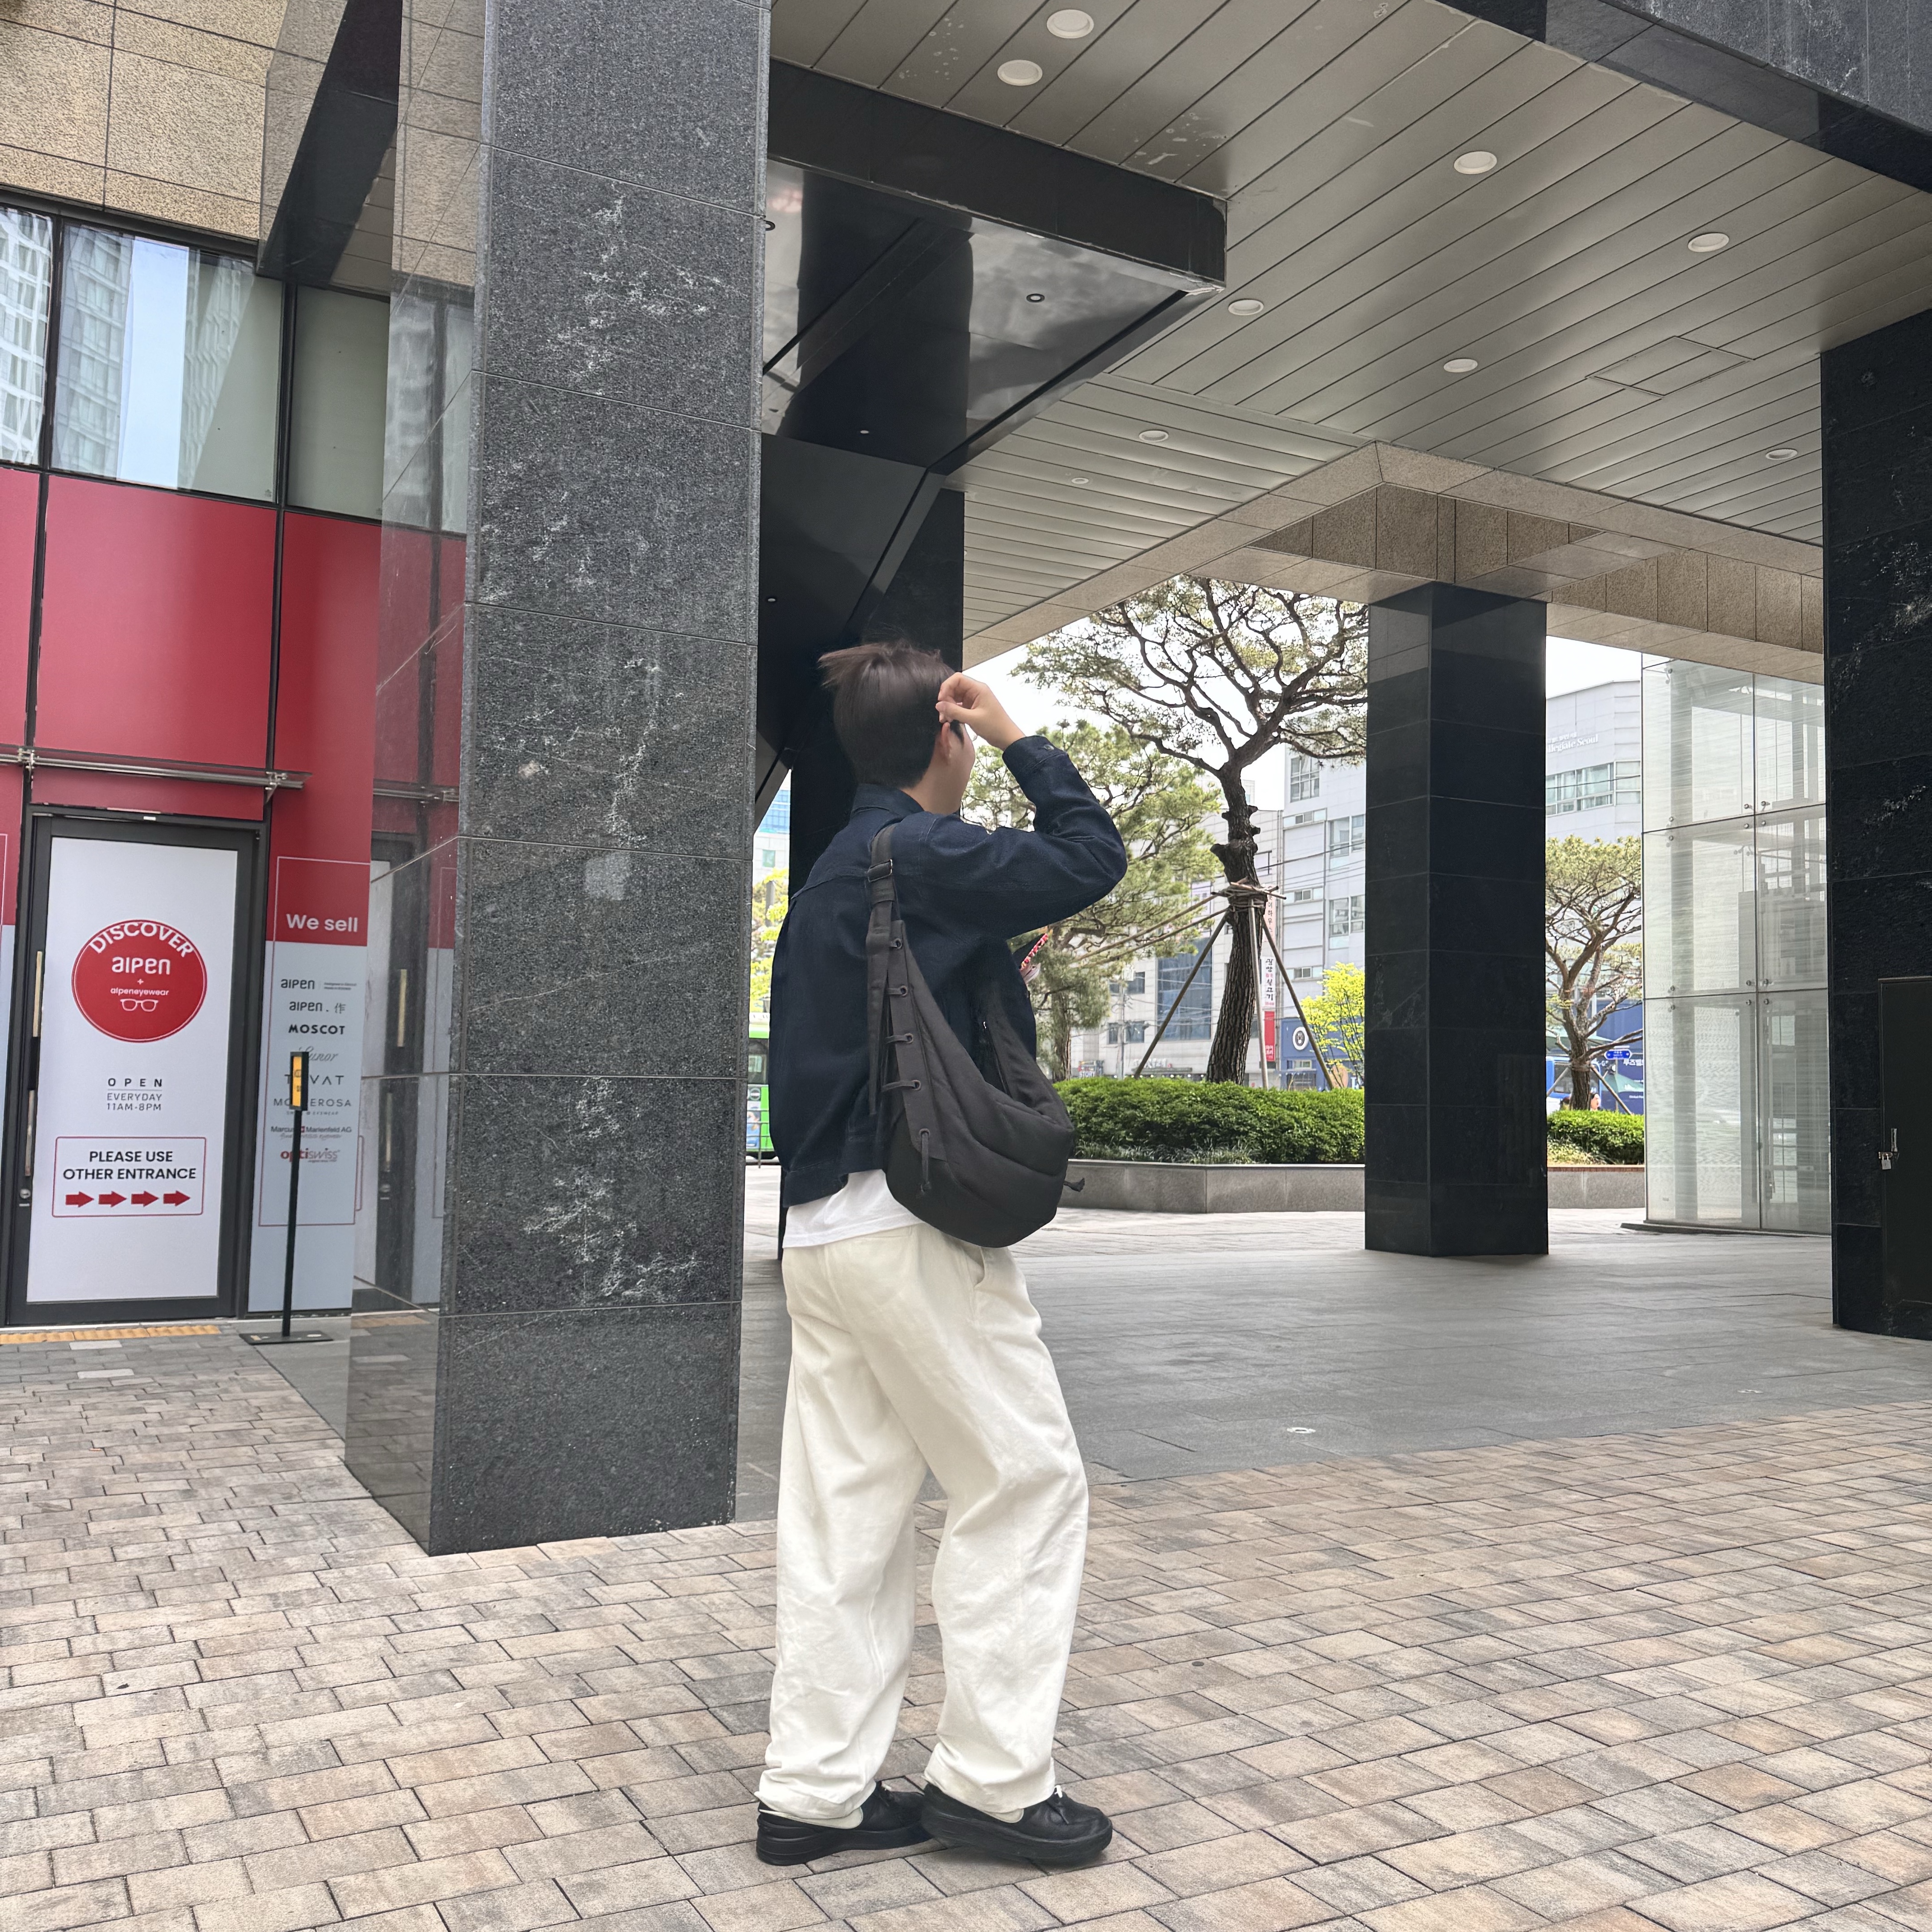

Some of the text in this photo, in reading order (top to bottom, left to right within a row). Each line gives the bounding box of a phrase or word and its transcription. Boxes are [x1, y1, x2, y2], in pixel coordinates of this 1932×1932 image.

[1577, 734, 1598, 746] Seoul
[286, 914, 358, 933] We sell
[89, 922, 194, 957] DISCOVER
[110, 987, 170, 997] alpeneyewear
[288, 1024, 345, 1035] MOSCOT
[108, 1078, 162, 1087] OPEN
[284, 1074, 344, 1085] TVAT
[107, 1093, 162, 1101] EVERYDAY
[273, 1098, 351, 1107] MOEROSA
[90, 1151, 173, 1162] PLEASE USE
[63, 1168, 197, 1180] OTHER ENTRANCE
